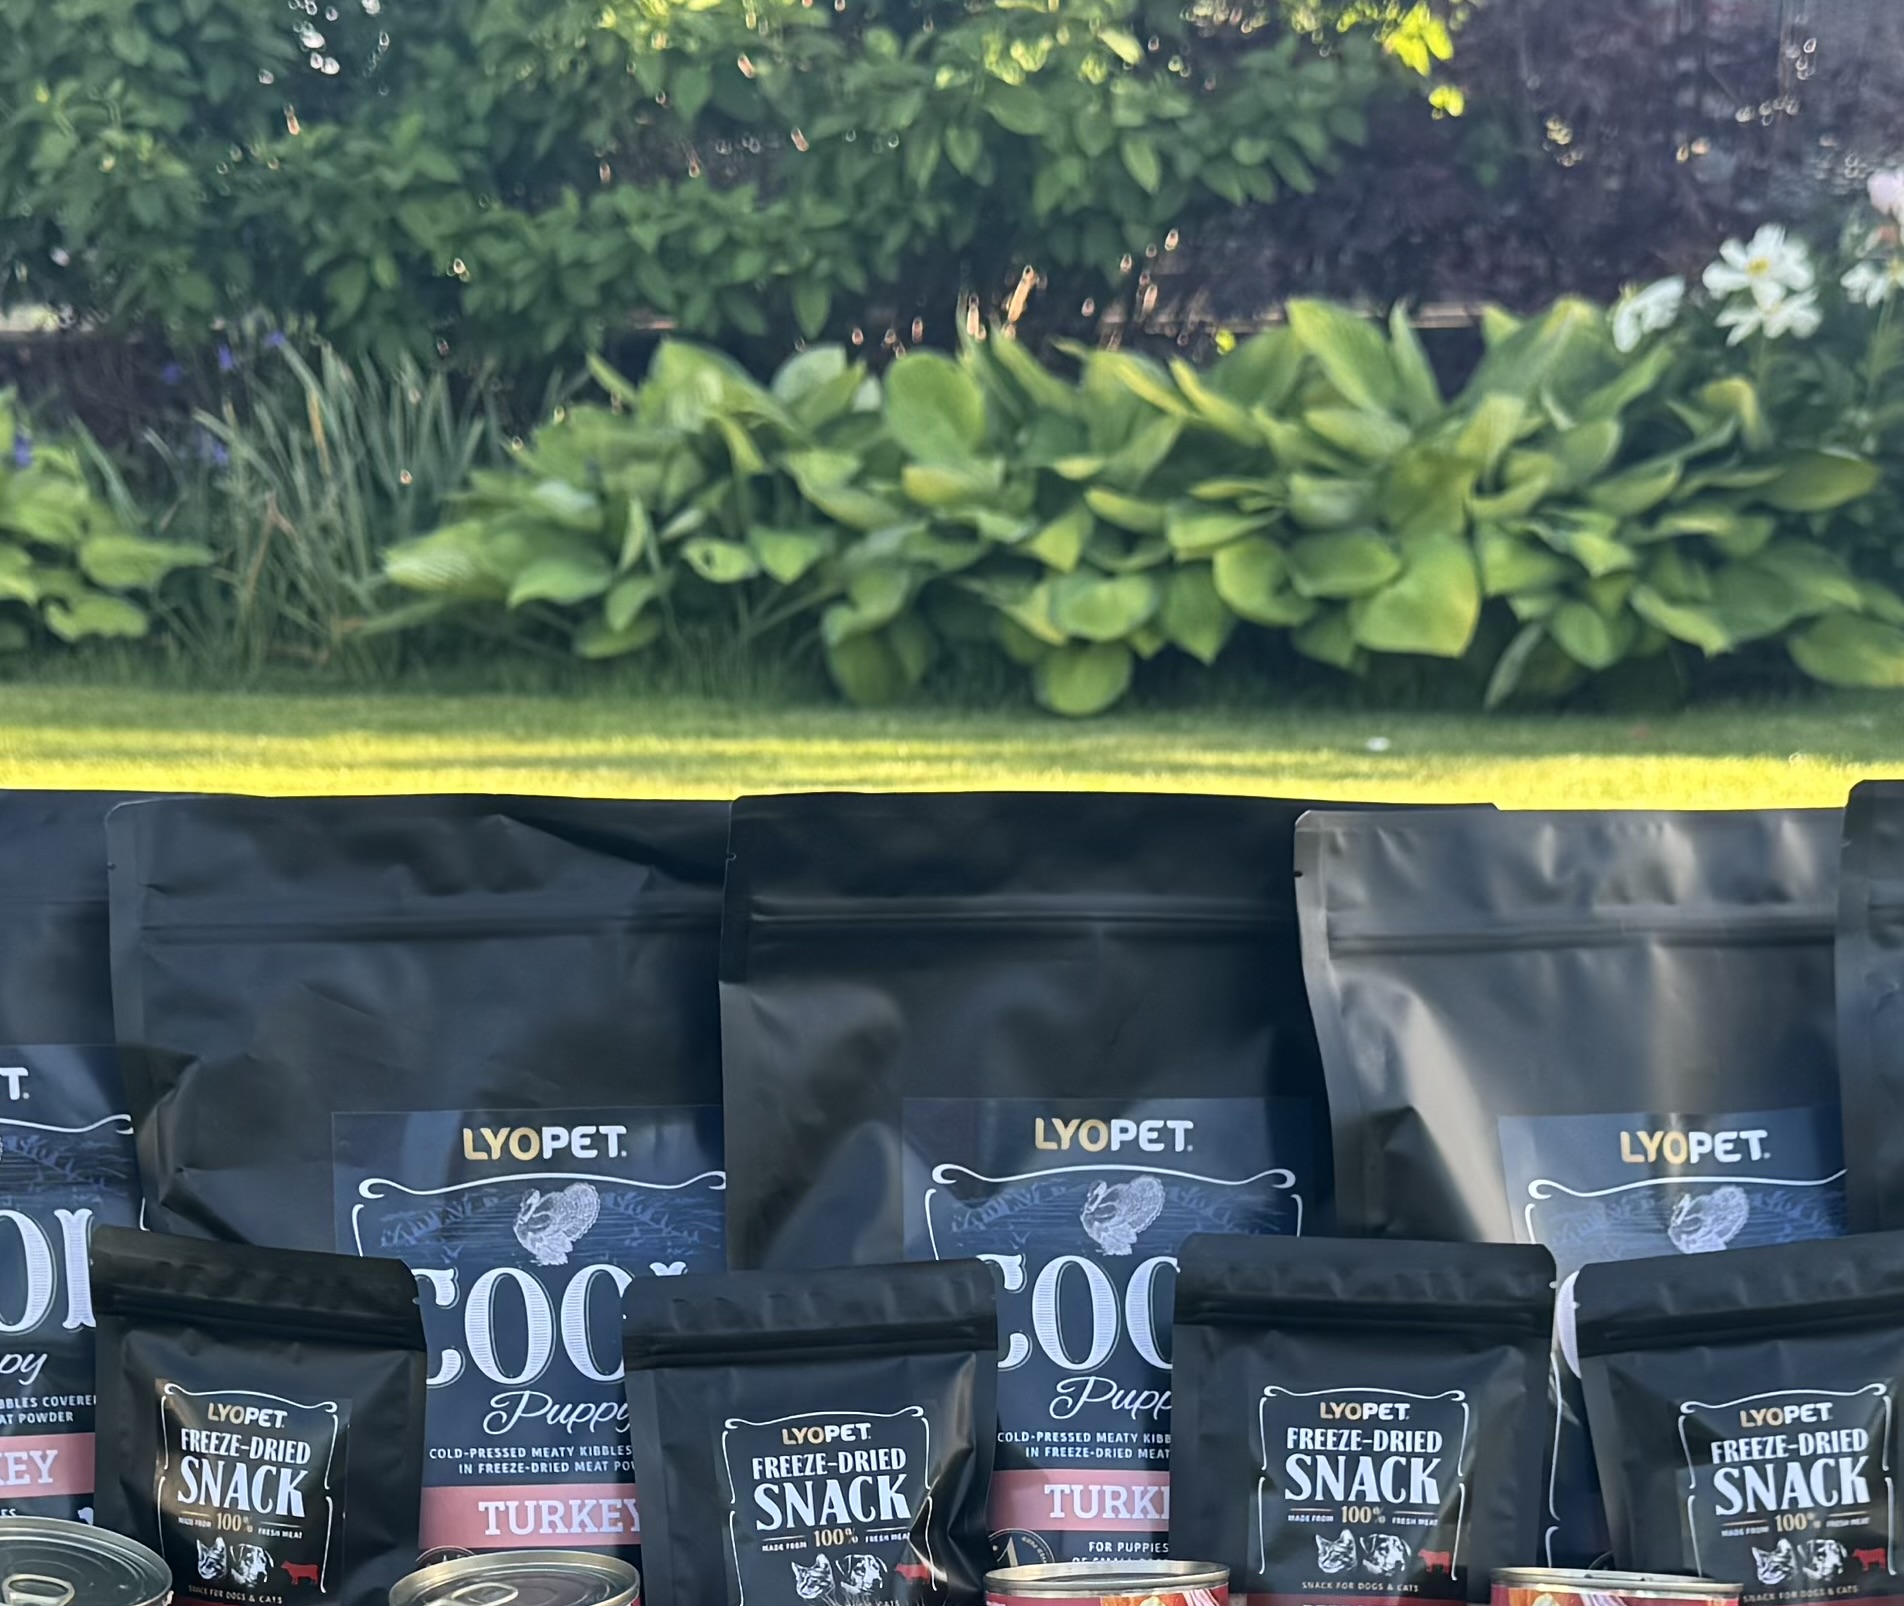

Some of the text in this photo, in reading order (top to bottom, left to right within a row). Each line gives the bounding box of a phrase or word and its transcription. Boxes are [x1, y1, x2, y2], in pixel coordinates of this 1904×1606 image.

[1049, 1376, 1172, 1420] Pupp
[19, 1412, 74, 1423] POWDER
[181, 1428, 311, 1464] FREEZE-DRIED
[429, 1445, 632, 1459] COLD-PRESSED MEATY KIBBLES
[997, 1432, 1171, 1444] COLD-PRESSED MEATY KIBB
[1026, 1447, 1170, 1459] IN FREEZE-DRIED MEAT
[1287, 1427, 1443, 1453] FREEZE-DRIED
[1711, 1428, 1869, 1464] FREEZE-DRIED
[459, 1464, 472, 1474] IN
[479, 1462, 569, 1473] FREEZE-DRIED
[575, 1461, 608, 1472] MEAT
[752, 1448, 907, 1480] FREEZE-DRIED
[1285, 1454, 1441, 1504] SNACK
[177, 1456, 309, 1517] SNACK
[754, 1474, 912, 1530] SNACK
[1044, 1484, 1170, 1519] TURK
[1713, 1456, 1870, 1516] SNACK
[478, 1498, 640, 1536] TURKEY
[1089, 1542, 1168, 1552] FOR PUPPIES
